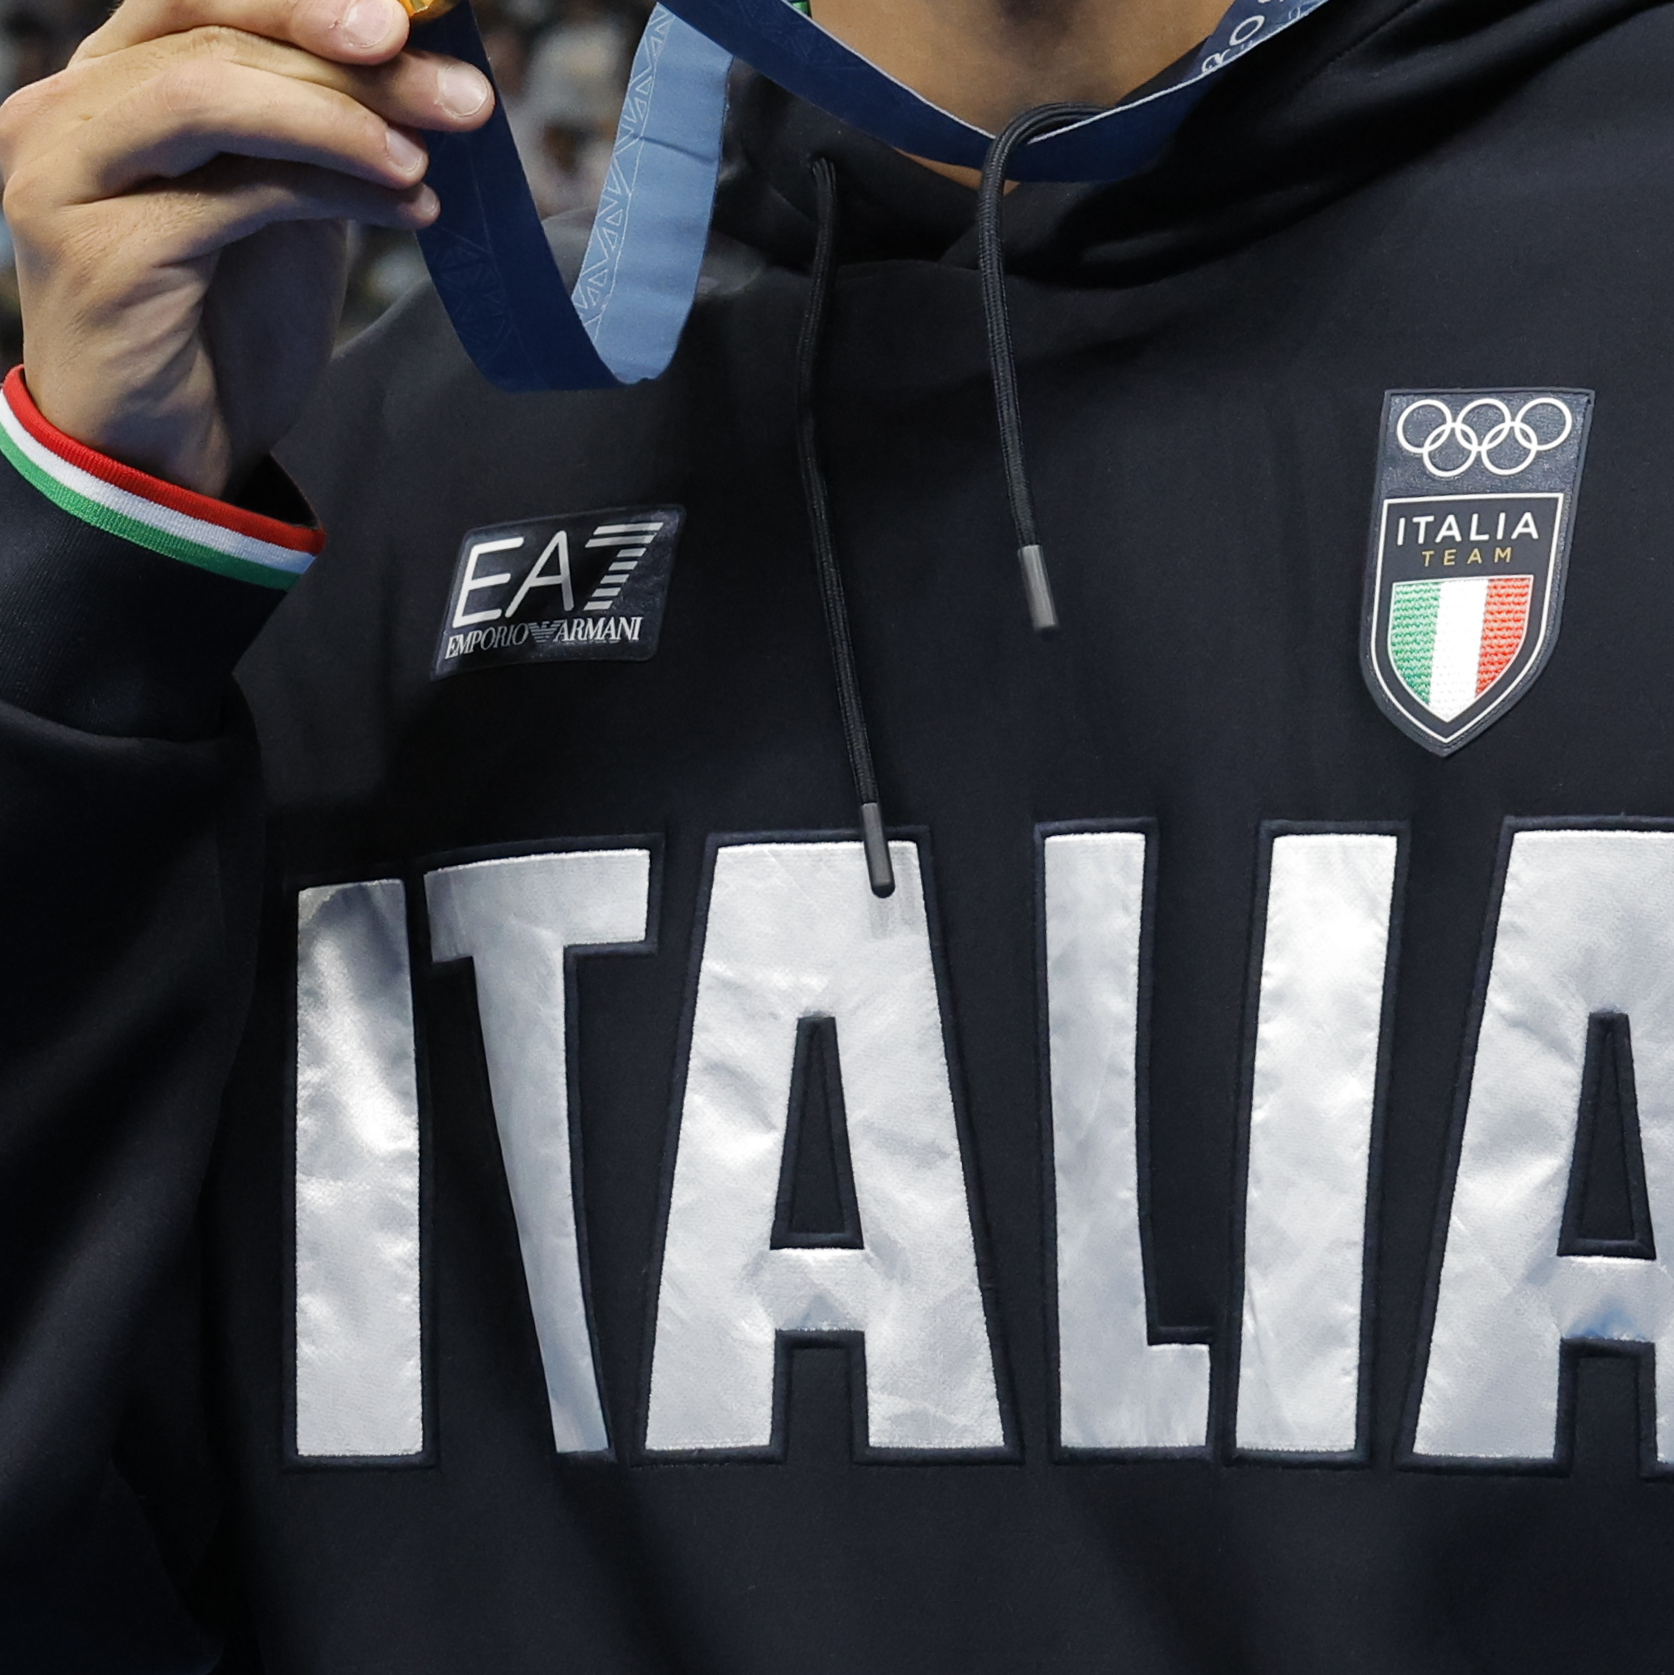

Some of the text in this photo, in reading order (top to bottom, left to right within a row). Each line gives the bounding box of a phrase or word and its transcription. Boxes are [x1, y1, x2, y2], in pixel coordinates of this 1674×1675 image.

[1395, 511, 1539, 546] ITALIA
[452, 522, 664, 628] EA7
[1421, 546, 1513, 567] TEAM
[444, 616, 644, 660] EMPORIO ARMANI
